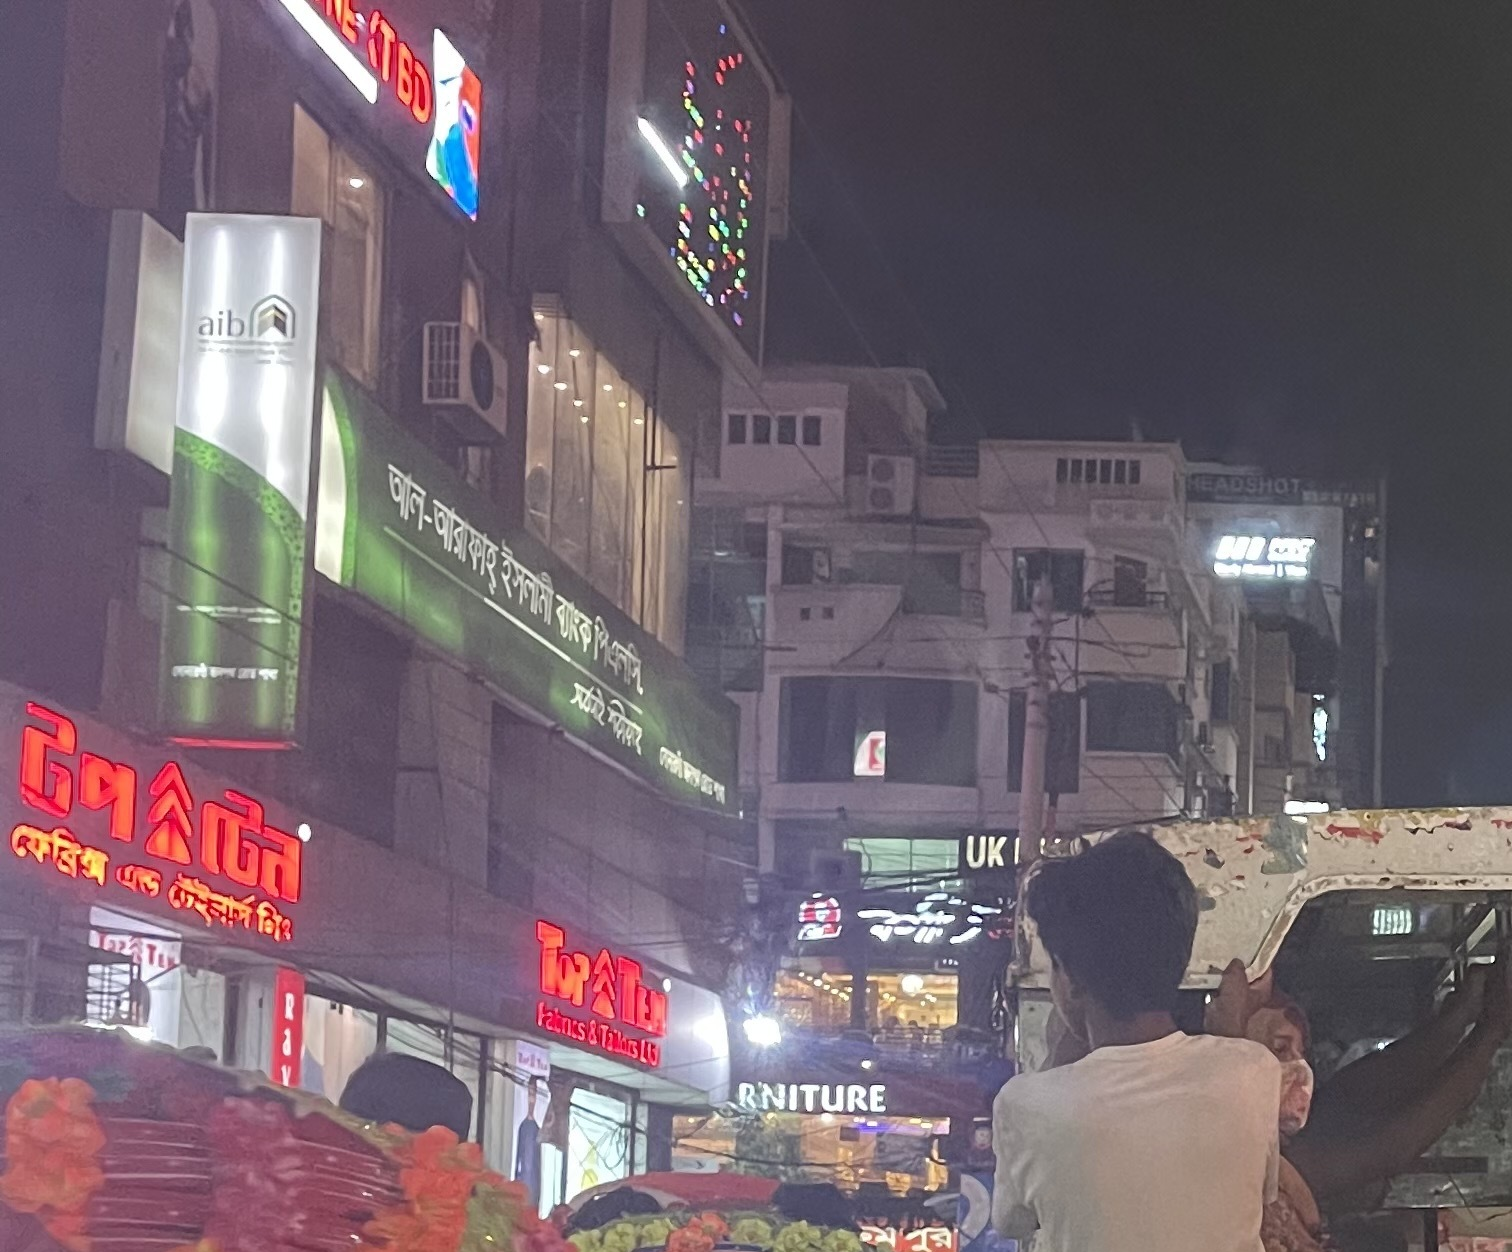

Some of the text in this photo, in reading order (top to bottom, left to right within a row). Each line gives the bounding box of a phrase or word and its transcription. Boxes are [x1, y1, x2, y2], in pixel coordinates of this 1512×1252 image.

[198, 309, 245, 337] aib
[501, 539, 554, 626] ইসলামী
[556, 594, 593, 653] ব্যাংক
[21, 701, 302, 903] টপ টেন
[966, 835, 1007, 869] UK
[588, 1018, 598, 1046] &
[738, 1082, 887, 1113] RNITURE
